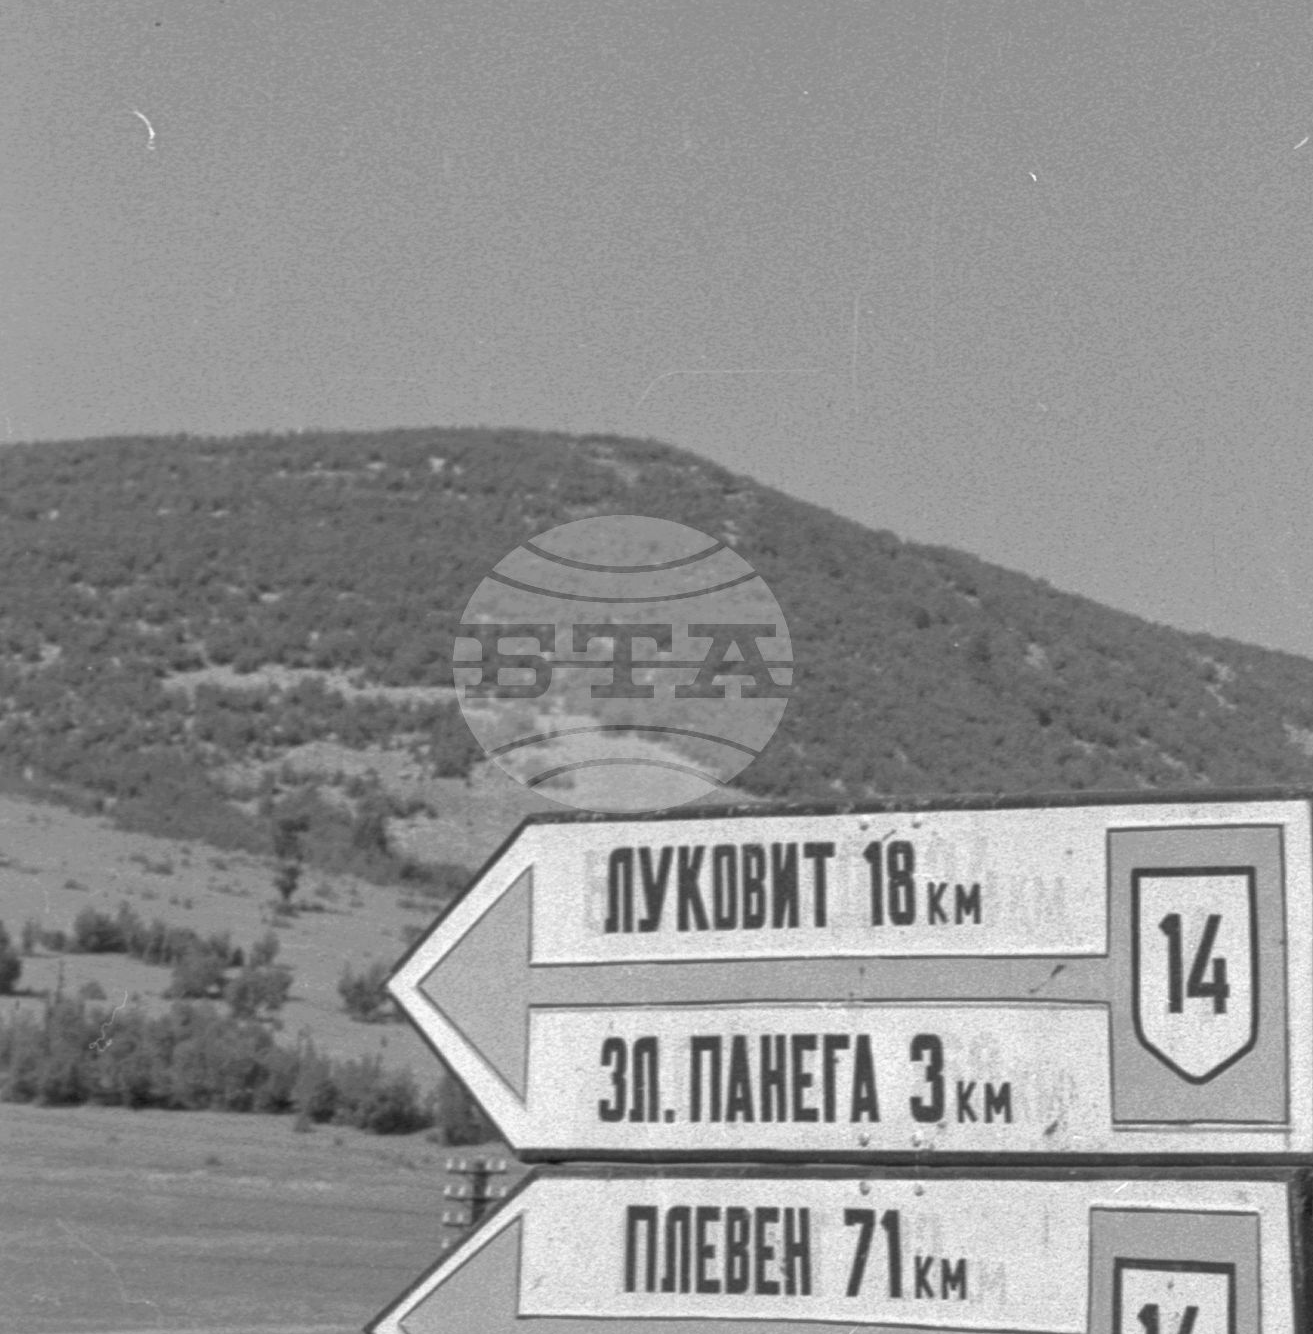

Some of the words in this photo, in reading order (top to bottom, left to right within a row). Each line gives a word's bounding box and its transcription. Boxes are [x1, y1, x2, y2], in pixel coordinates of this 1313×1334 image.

[605, 842, 834, 933] ЛУКОВИТ
[863, 841, 915, 926] 18
[1160, 914, 1229, 1014] 14
[910, 1034, 946, 1123] 3
[625, 1205, 811, 1295] ПЛЕВЕН
[844, 1209, 902, 1298] 71
